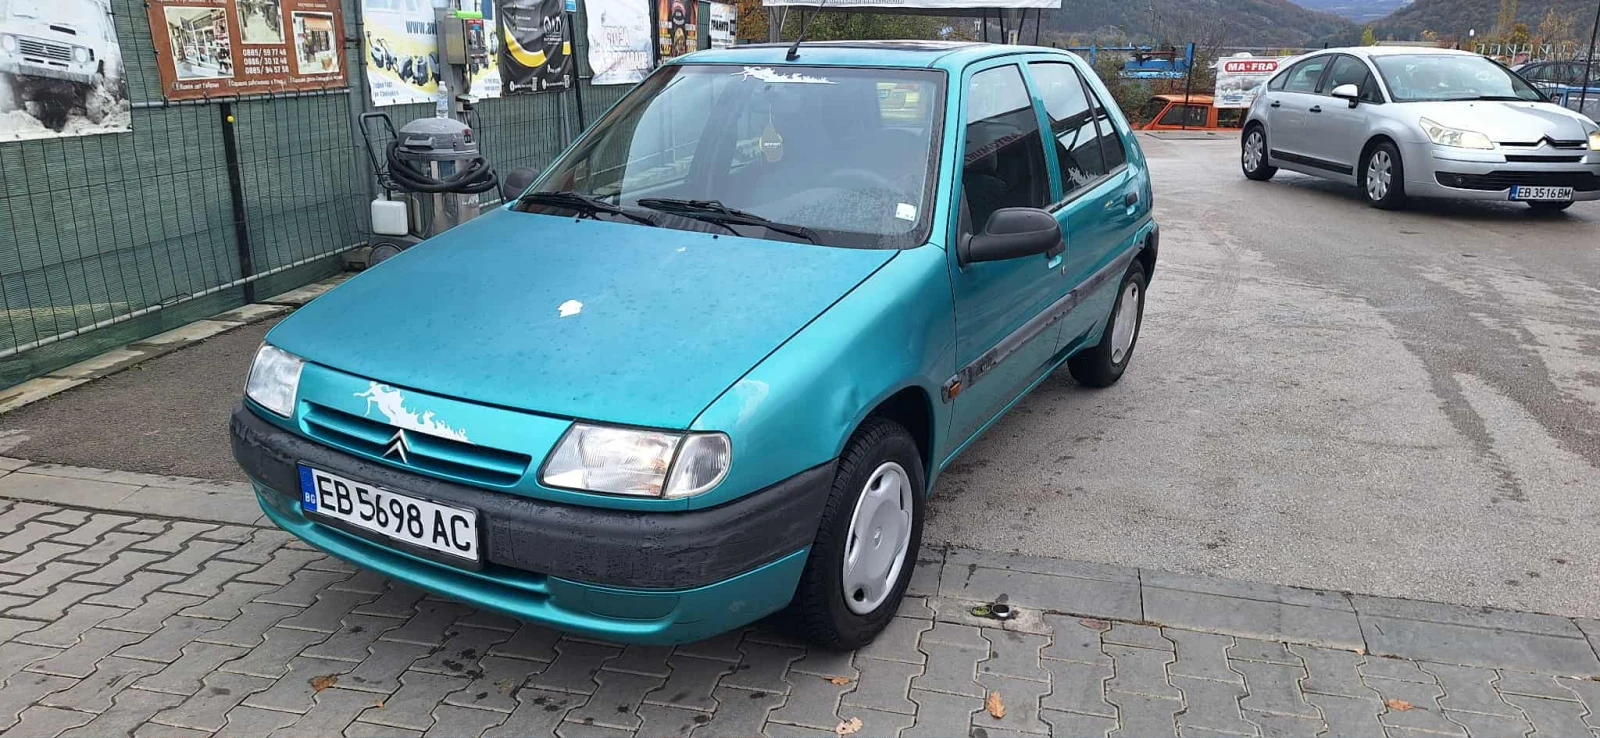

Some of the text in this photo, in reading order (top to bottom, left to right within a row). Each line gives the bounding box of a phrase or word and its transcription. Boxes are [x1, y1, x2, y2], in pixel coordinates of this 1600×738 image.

[271, 48, 278, 56] 77
[1518, 188, 1571, 198] EB 3516 BM
[305, 492, 316, 504] BG
[316, 475, 471, 552] EB 5698 AC
